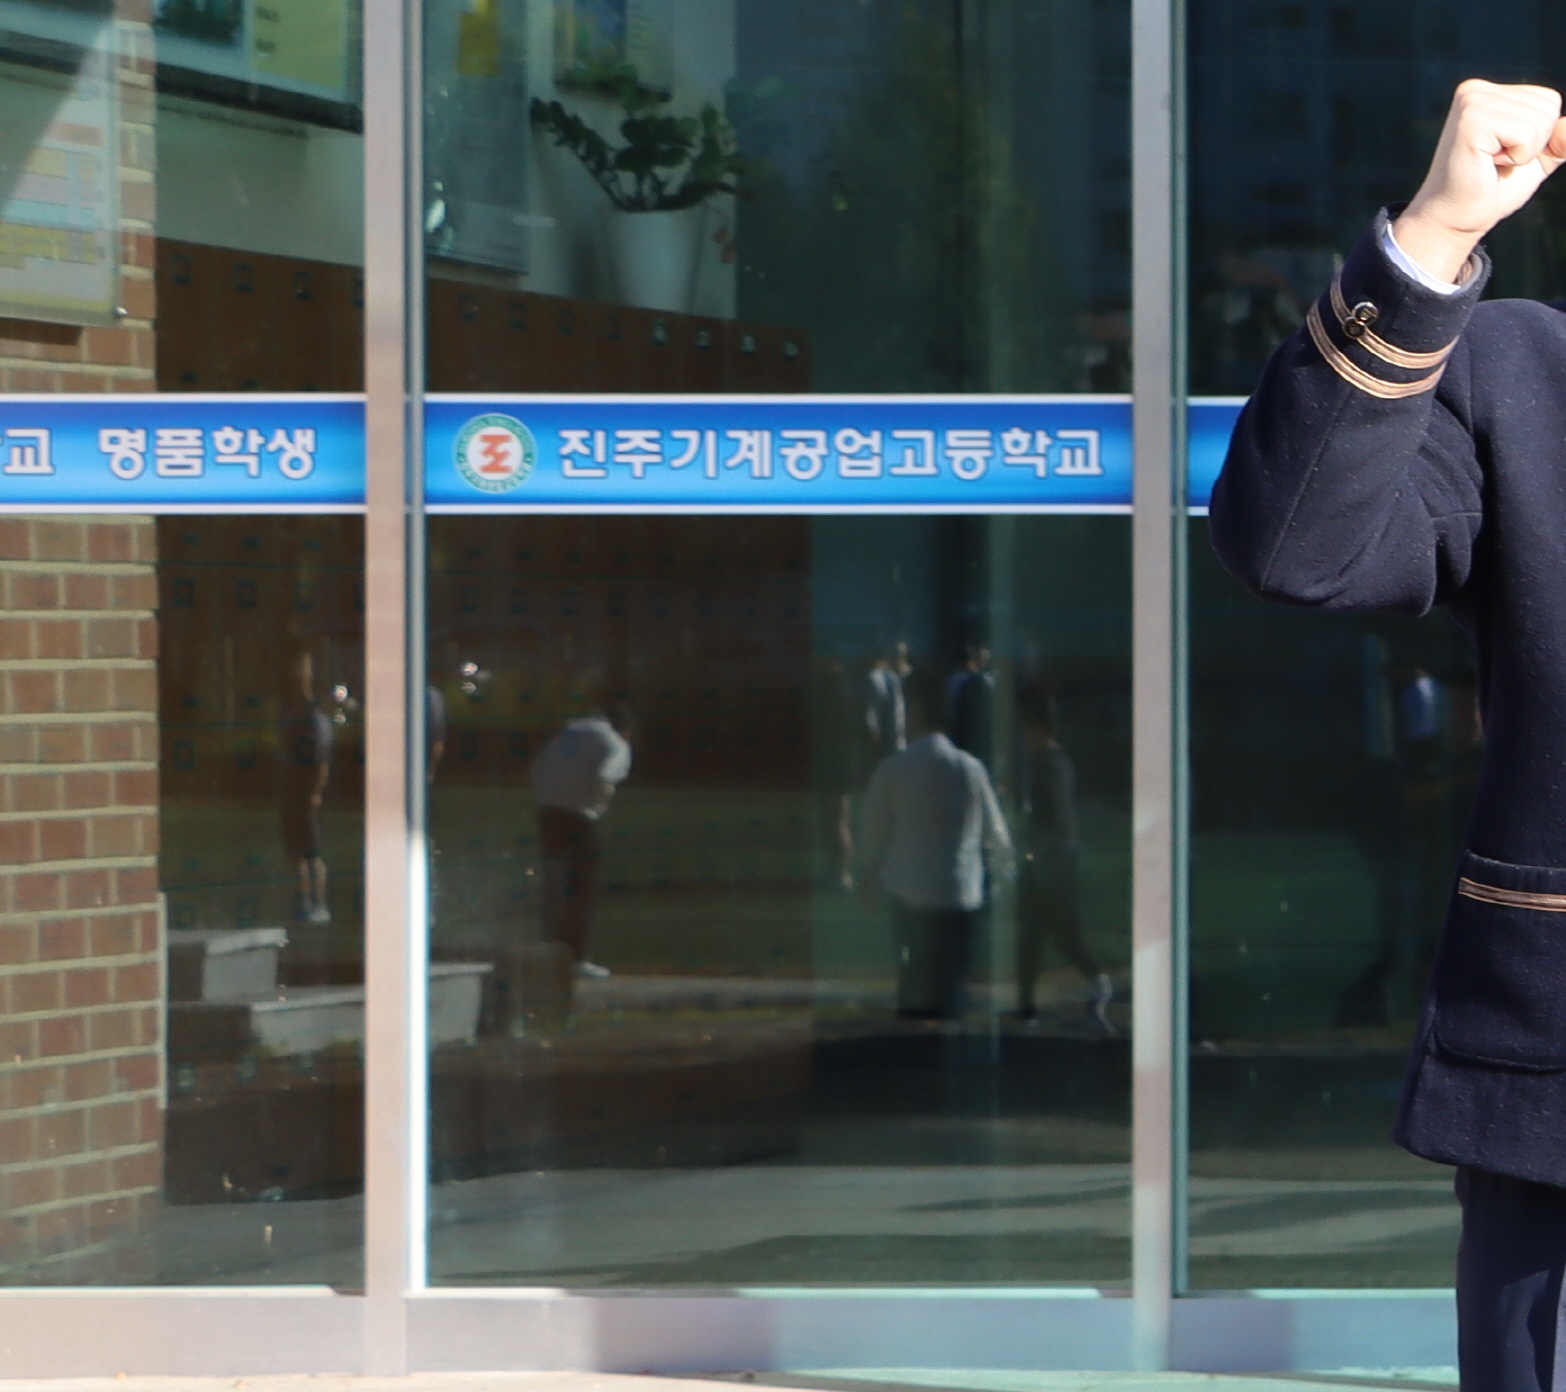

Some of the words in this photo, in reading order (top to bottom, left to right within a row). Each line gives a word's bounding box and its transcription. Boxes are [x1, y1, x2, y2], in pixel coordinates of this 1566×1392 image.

[0, 428, 54, 474] 교
[99, 426, 316, 479] 명품학생
[558, 427, 1103, 480] 진주기계공업고등학교
